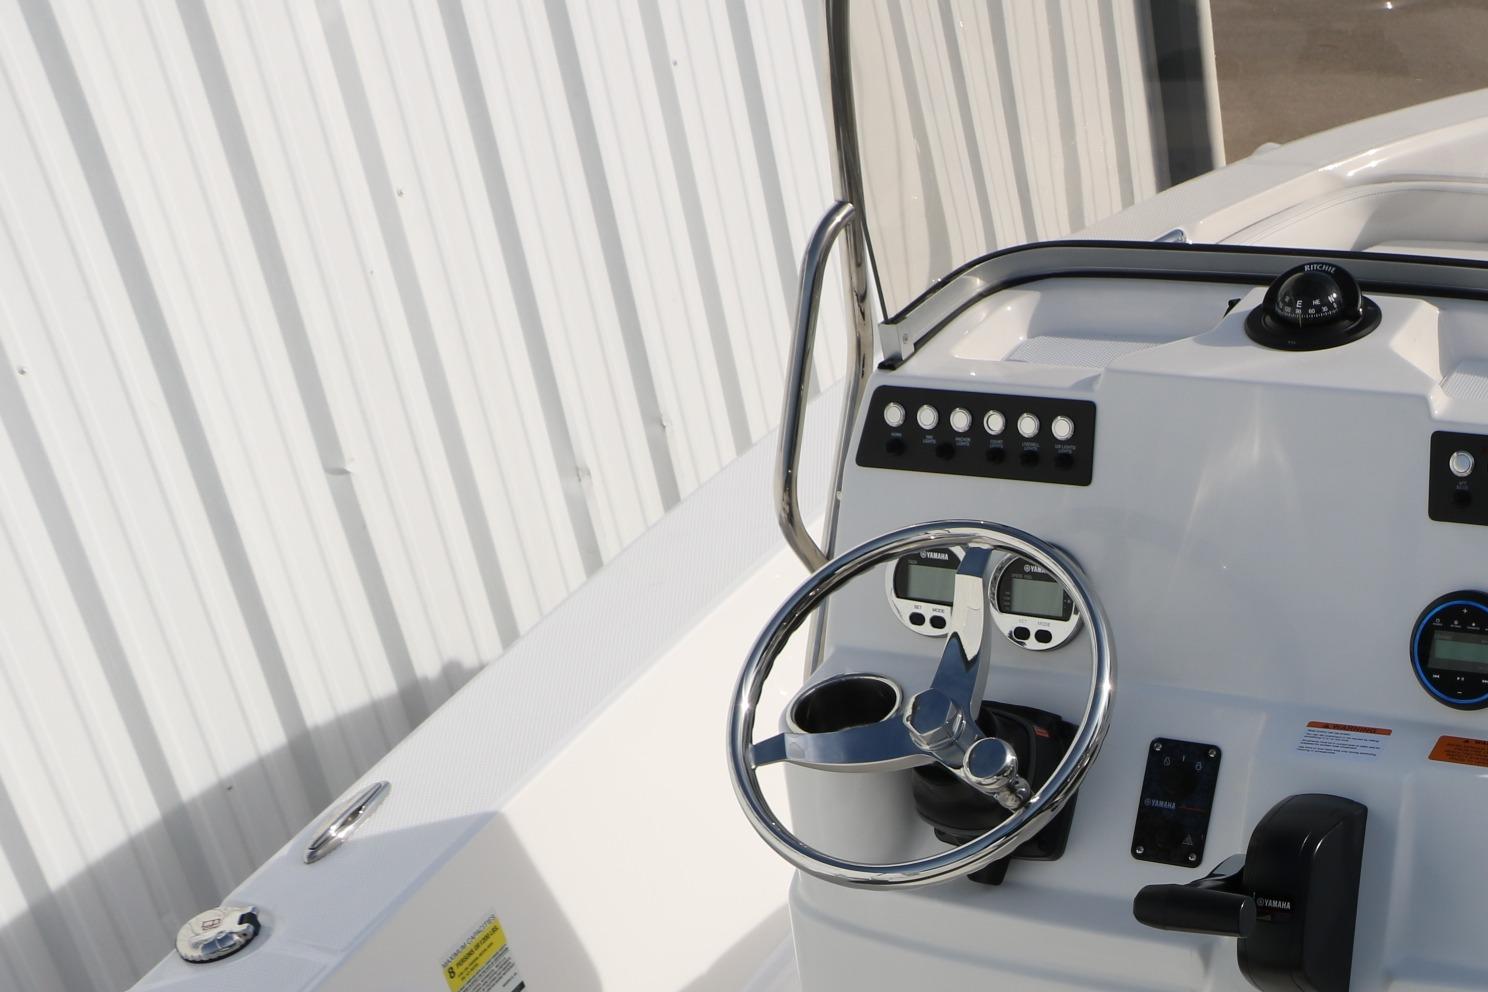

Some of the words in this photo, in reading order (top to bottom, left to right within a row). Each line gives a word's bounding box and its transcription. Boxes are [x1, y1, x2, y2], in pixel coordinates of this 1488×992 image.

[1304, 264, 1337, 274] RITCHIE
[1296, 300, 1303, 308] E
[926, 551, 949, 560] YAMAHA
[1151, 799, 1176, 809] YAMAHA
[1264, 898, 1291, 910] YAMAHA
[447, 967, 456, 979] 8
